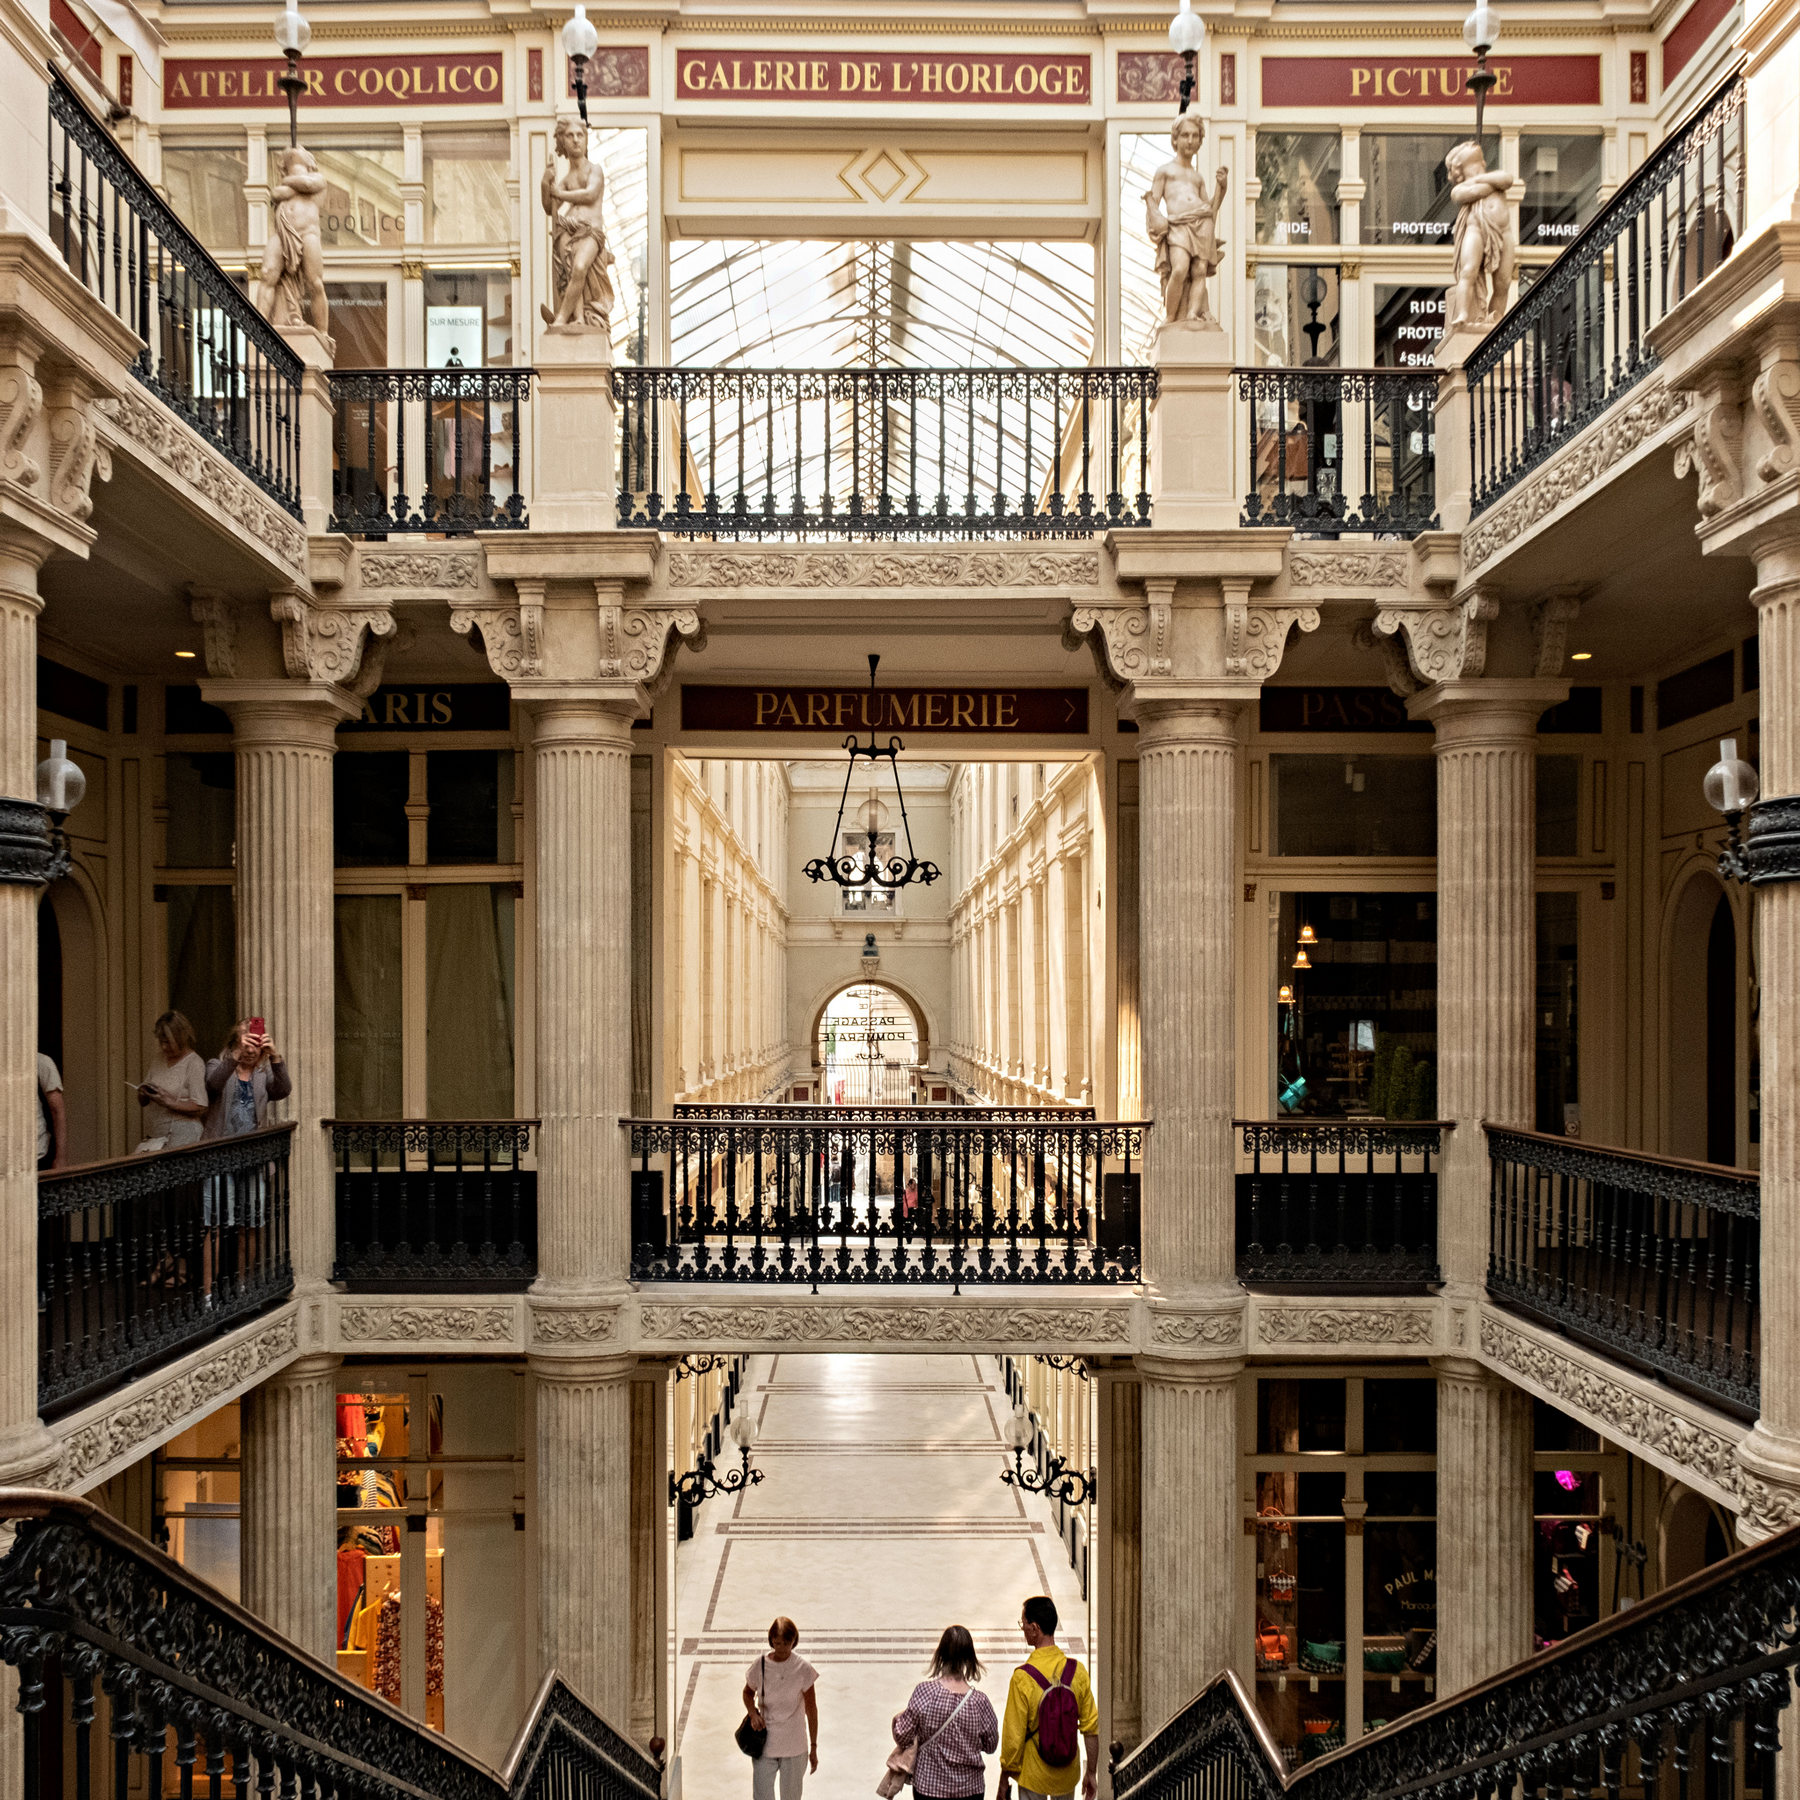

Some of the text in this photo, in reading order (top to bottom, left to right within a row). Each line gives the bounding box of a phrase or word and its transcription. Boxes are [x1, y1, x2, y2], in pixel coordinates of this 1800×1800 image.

[334, 64, 499, 100] COQLICO
[682, 60, 1084, 95] GALERIE DE L'HORLOGE
[319, 214, 405, 234] OQLICO
[1393, 222, 1450, 235] PROTECT
[1537, 224, 1580, 237] SHARE
[430, 318, 480, 327] SUR MESURE
[1400, 351, 1435, 366] &SHA
[346, 692, 453, 724] ARIS
[753, 692, 1019, 727] PARFUMERIE
[1300, 692, 1403, 725] PASS
[1384, 1569, 1436, 1595] PAUL M
